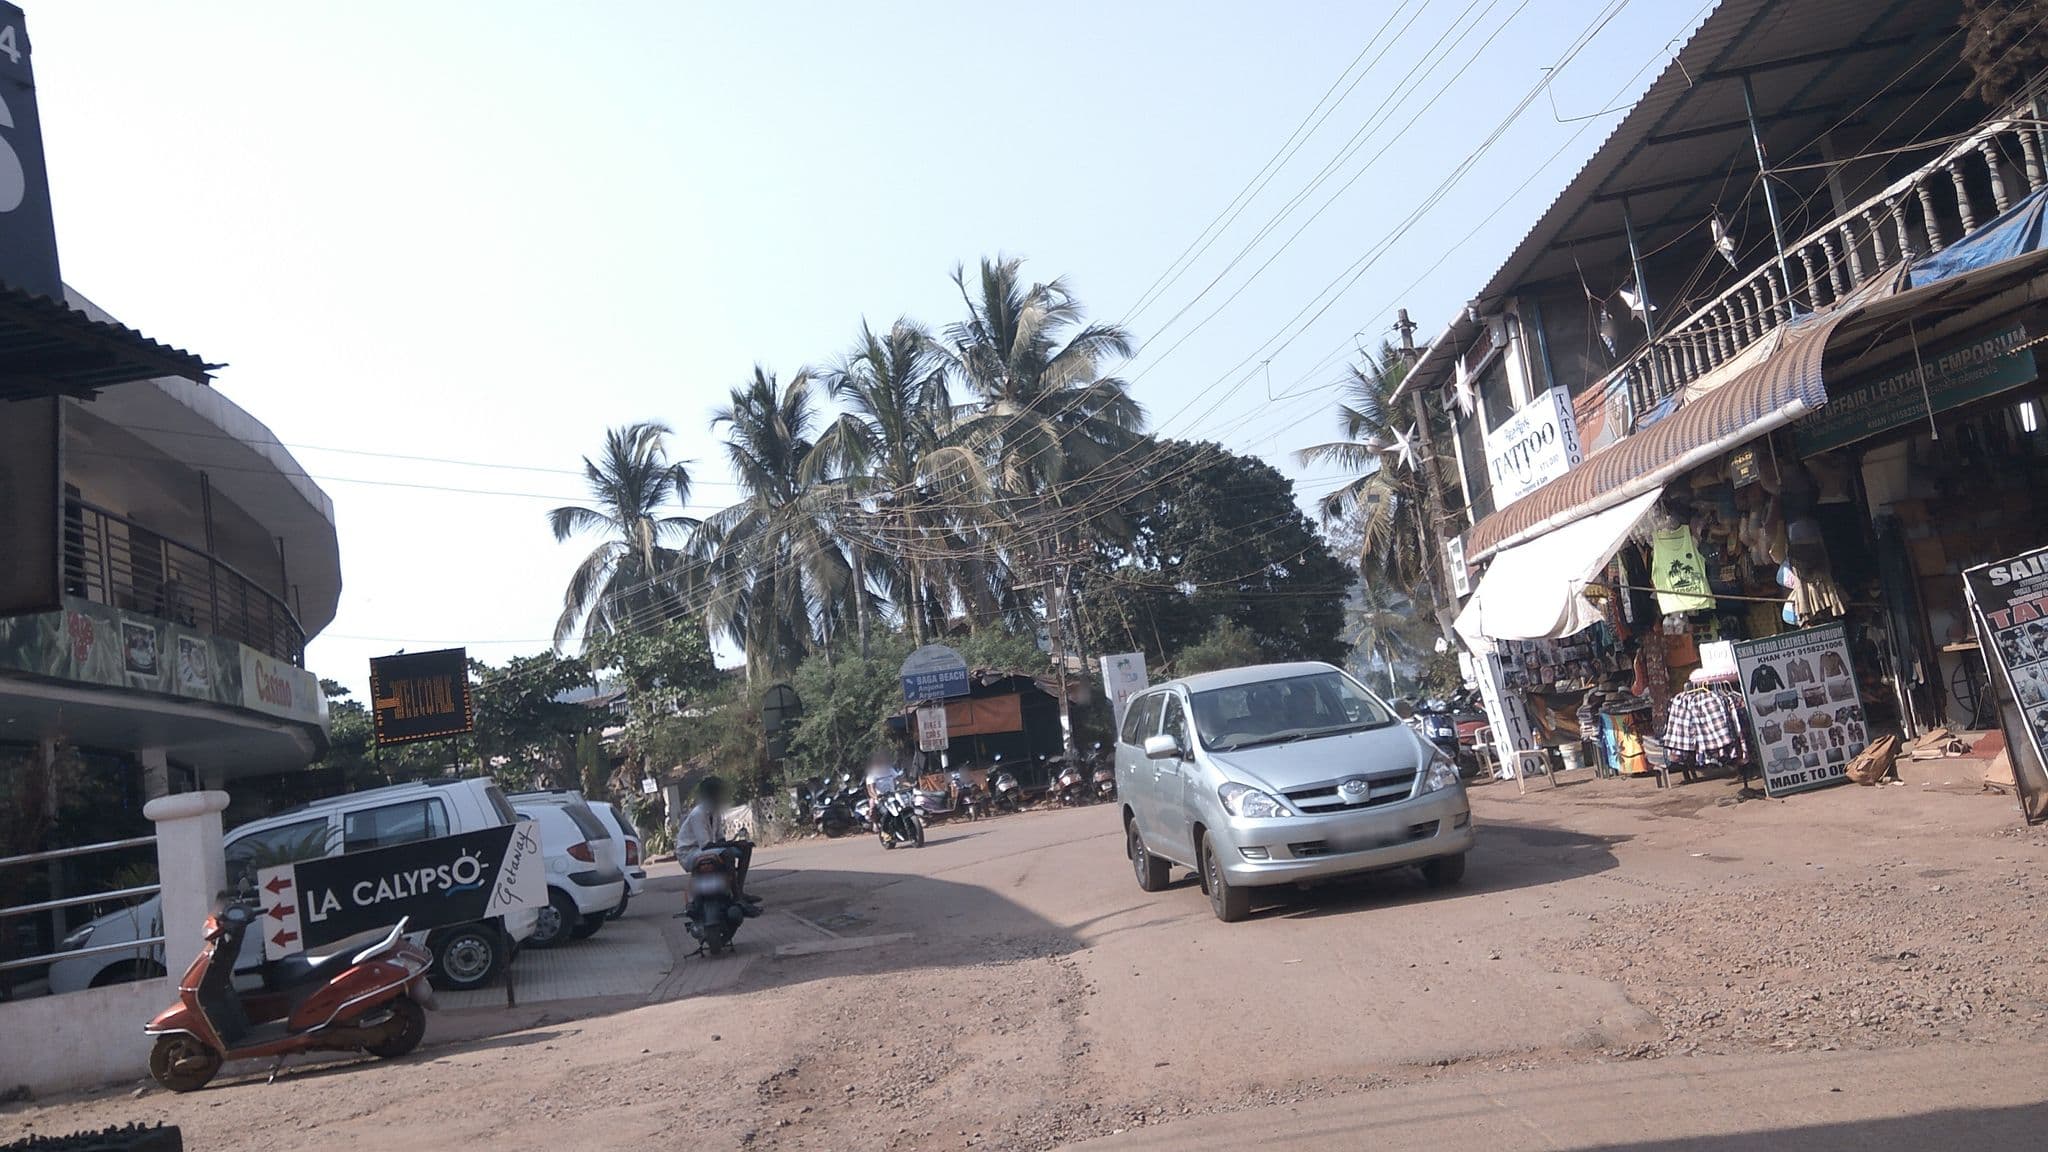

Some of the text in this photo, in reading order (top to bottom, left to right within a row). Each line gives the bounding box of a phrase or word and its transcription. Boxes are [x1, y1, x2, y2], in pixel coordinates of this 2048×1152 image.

[1825, 388, 1867, 416] AFFAIR
[1556, 393, 1581, 465] TATTOO
[1492, 422, 1554, 485] TATTOO
[1737, 627, 1844, 659] SKIN AFFAIR LEATHER EMPORIUM
[1757, 653, 1781, 664] KHAN
[255, 659, 292, 708] Casino
[939, 671, 966, 682] BEACH
[1770, 770, 1809, 789] MADE
[1810, 767, 1827, 781] TO
[493, 825, 538, 908] Getaway
[306, 852, 485, 923] LA CALYPSO
